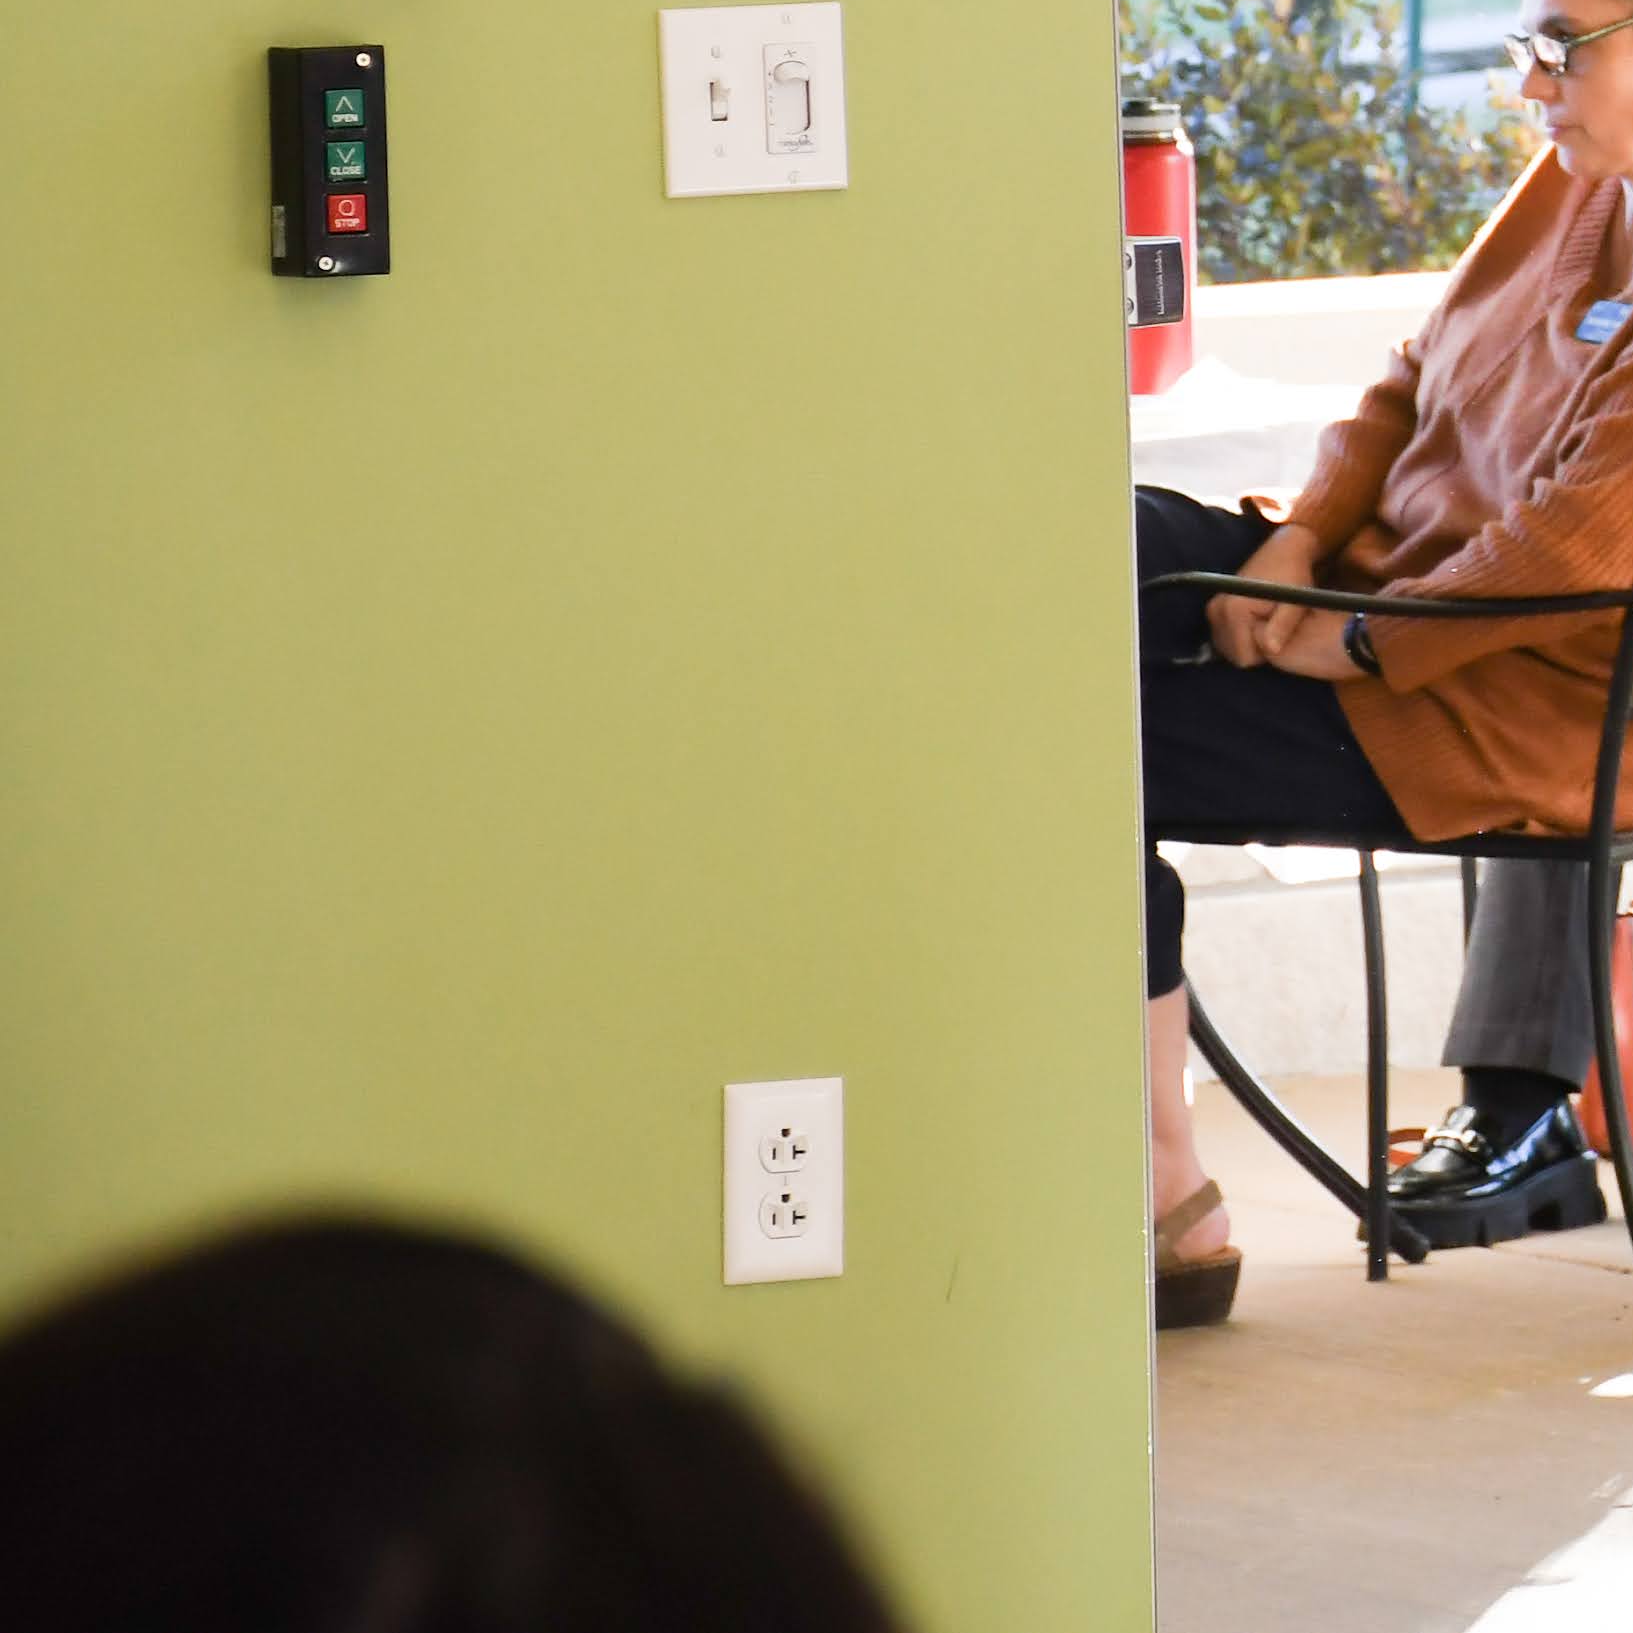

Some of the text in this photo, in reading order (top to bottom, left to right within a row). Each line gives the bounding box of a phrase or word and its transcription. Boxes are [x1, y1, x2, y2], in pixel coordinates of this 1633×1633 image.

[332, 114, 359, 123] OPEN
[330, 166, 361, 176] CLOSE
[335, 219, 360, 228] STOP
